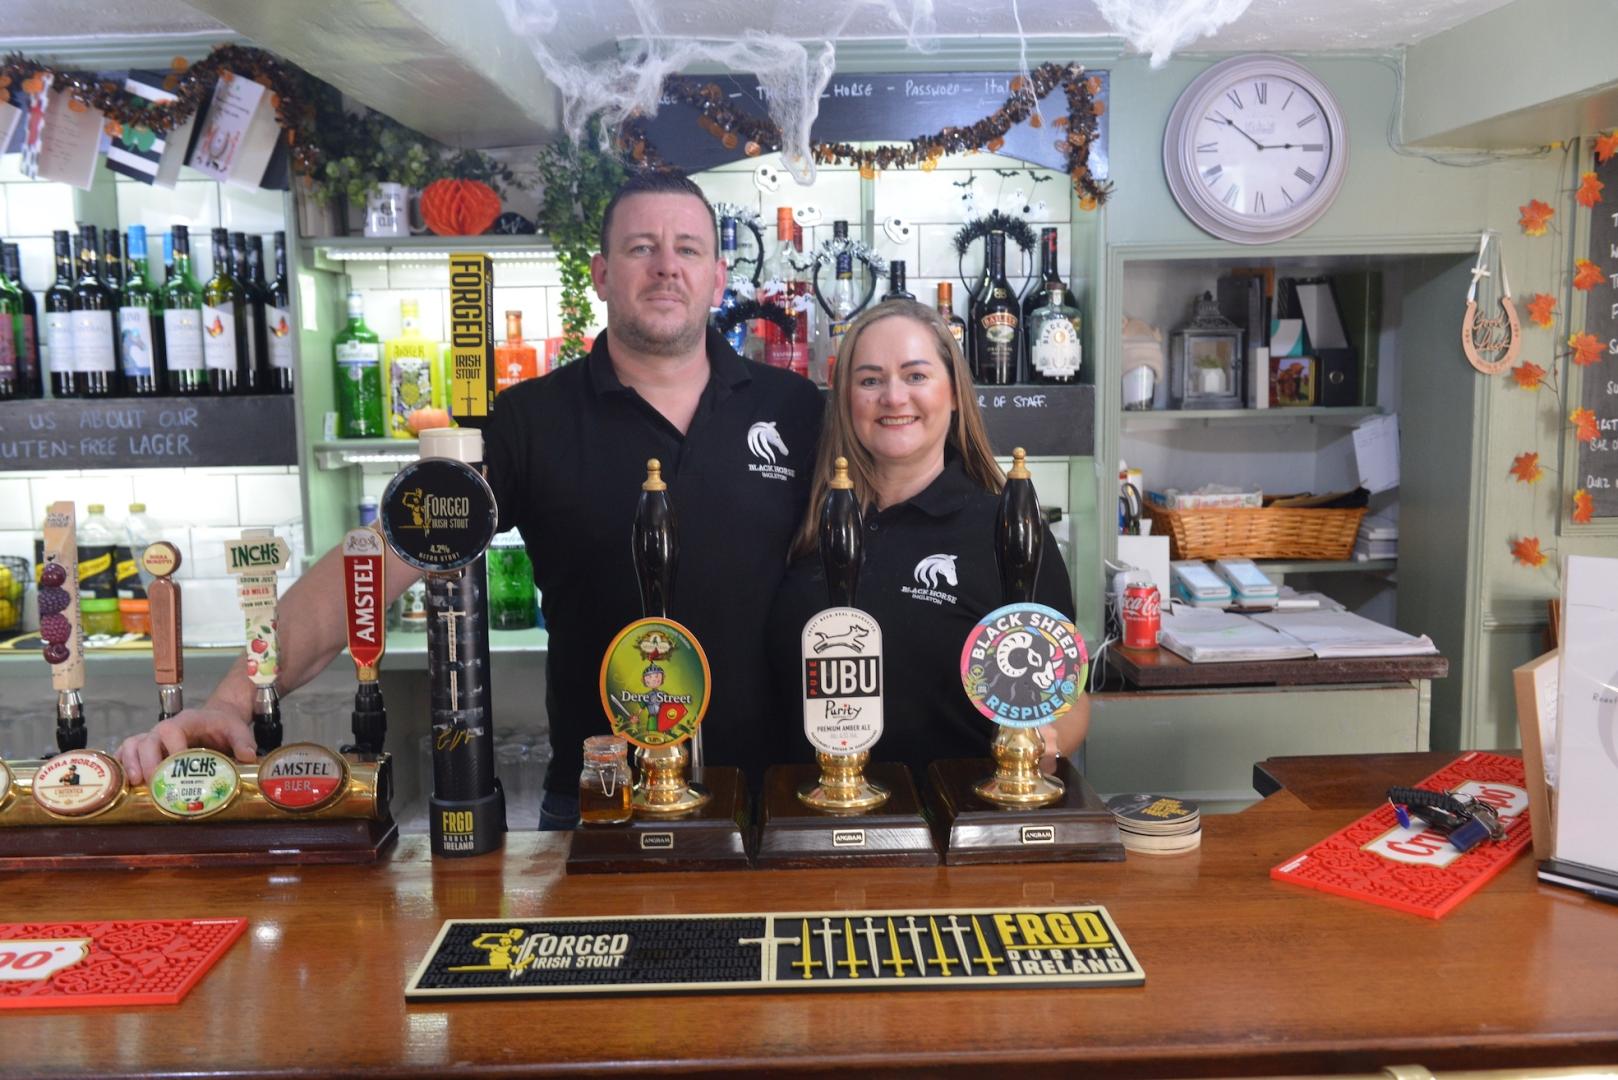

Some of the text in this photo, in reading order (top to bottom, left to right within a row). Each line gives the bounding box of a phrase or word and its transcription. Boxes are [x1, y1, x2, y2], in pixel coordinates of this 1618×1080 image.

[834, 83, 874, 98] HORSE
[451, 260, 483, 348] FORGED
[455, 354, 481, 367] IRISH
[455, 368, 481, 380] STOUT
[993, 395, 1007, 408] OF
[29, 407, 199, 431] US ABOUT OUR
[0, 434, 192, 459] UTEN-FREE LAGER
[748, 464, 773, 472] BLACK
[425, 494, 470, 518] FORGED
[432, 518, 469, 529] IRISH STOUT
[430, 544, 451, 554] 4.2%
[353, 558, 376, 643] AMSTEL
[901, 586, 958, 605] BLACK HORSE
[971, 612, 1078, 660] BLACK SHEEP
[808, 660, 818, 697] PURE
[820, 658, 877, 695] UBU
[621, 690, 692, 704] Dere Street
[824, 700, 863, 725] Purity
[985, 693, 1064, 720] RESPIRE
[841, 724, 860, 732] AMBER
[39, 757, 106, 781] BIRRA MORETTI
[170, 757, 217, 778] INCH'S
[271, 762, 330, 777] AMSTEL
[181, 787, 202, 797] CIDER
[284, 780, 312, 792] BIER
[442, 811, 474, 832] FRGD
[443, 841, 475, 851] IRELAND
[992, 912, 1110, 946] FRGD
[524, 931, 630, 956] FORGED
[532, 954, 624, 969] IRISH STOUT
[1006, 947, 1120, 962] DUBLIN
[1009, 959, 1128, 976] IRELAND
